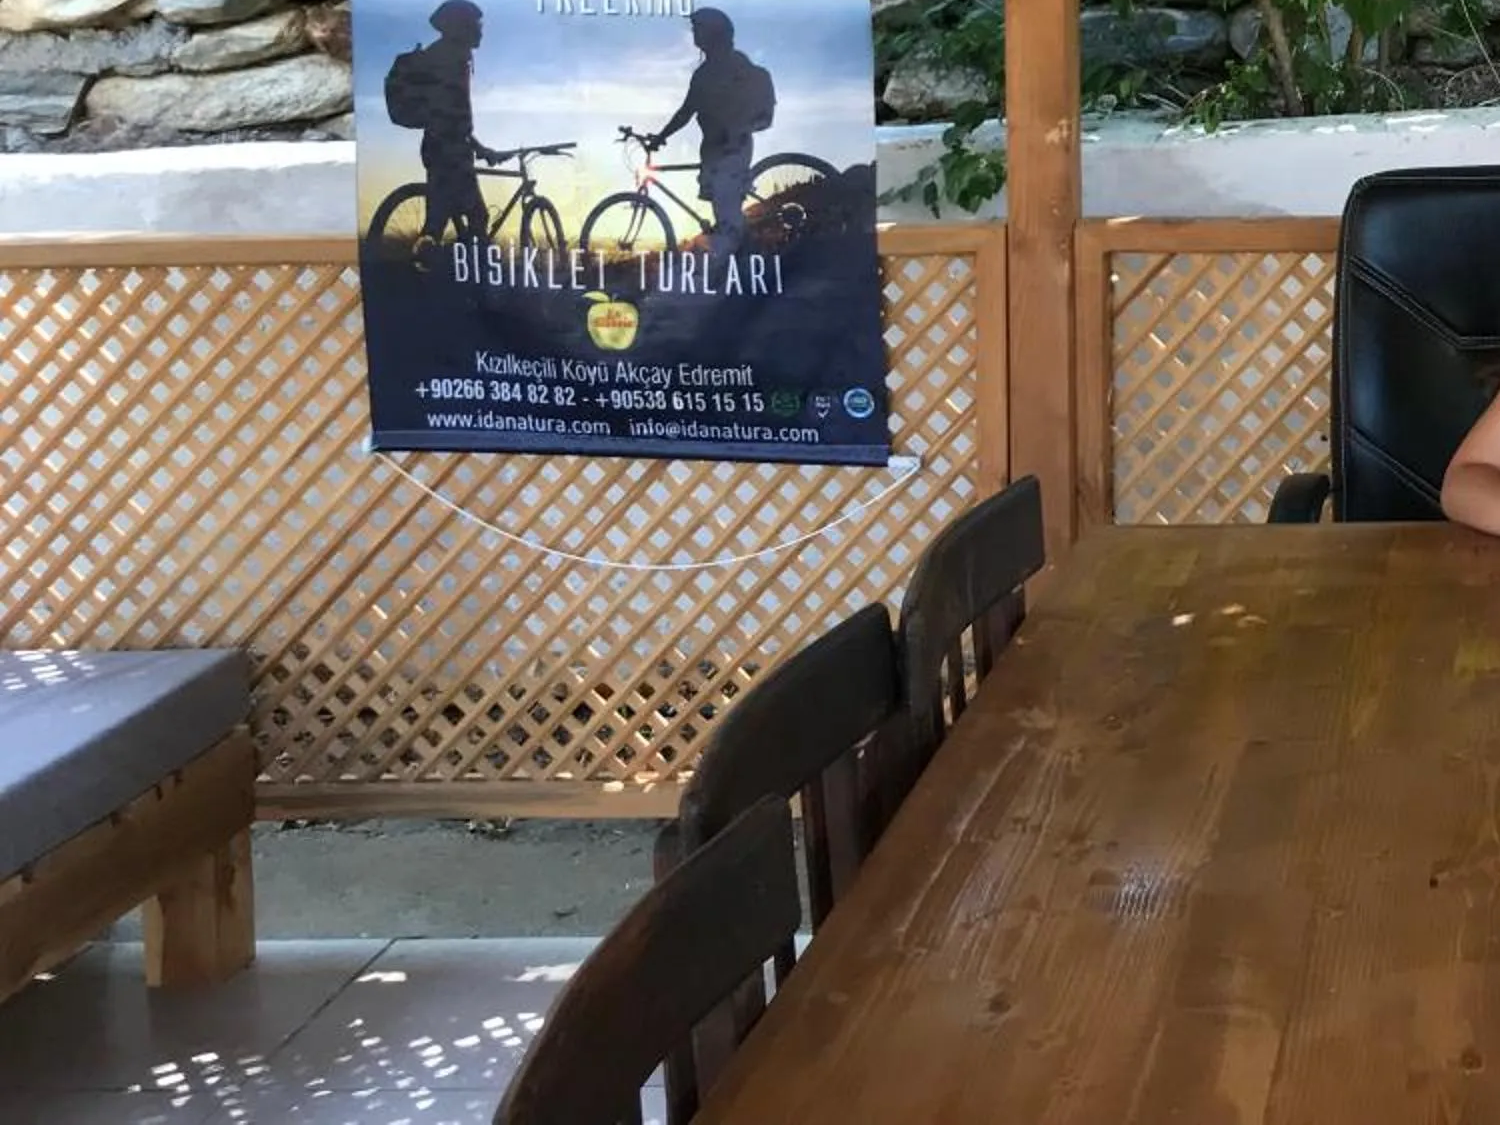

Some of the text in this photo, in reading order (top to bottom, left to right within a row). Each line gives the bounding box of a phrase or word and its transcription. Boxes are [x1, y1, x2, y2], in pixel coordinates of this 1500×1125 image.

[453, 235, 784, 295] BİSİKLET TURLARI
[561, 359, 609, 386] Köyü
[615, 361, 673, 389] Akçay
[679, 362, 753, 386] Edremit
[415, 378, 485, 399] +90266
[490, 380, 522, 402] 384
[528, 383, 549, 404] 82
[554, 385, 576, 406] 82
[595, 388, 666, 410] +90538
[672, 391, 706, 412] 615
[711, 391, 736, 412] 15
[742, 392, 765, 413] 15
[427, 410, 819, 443] www.idanatura.com info@idanatura.com
